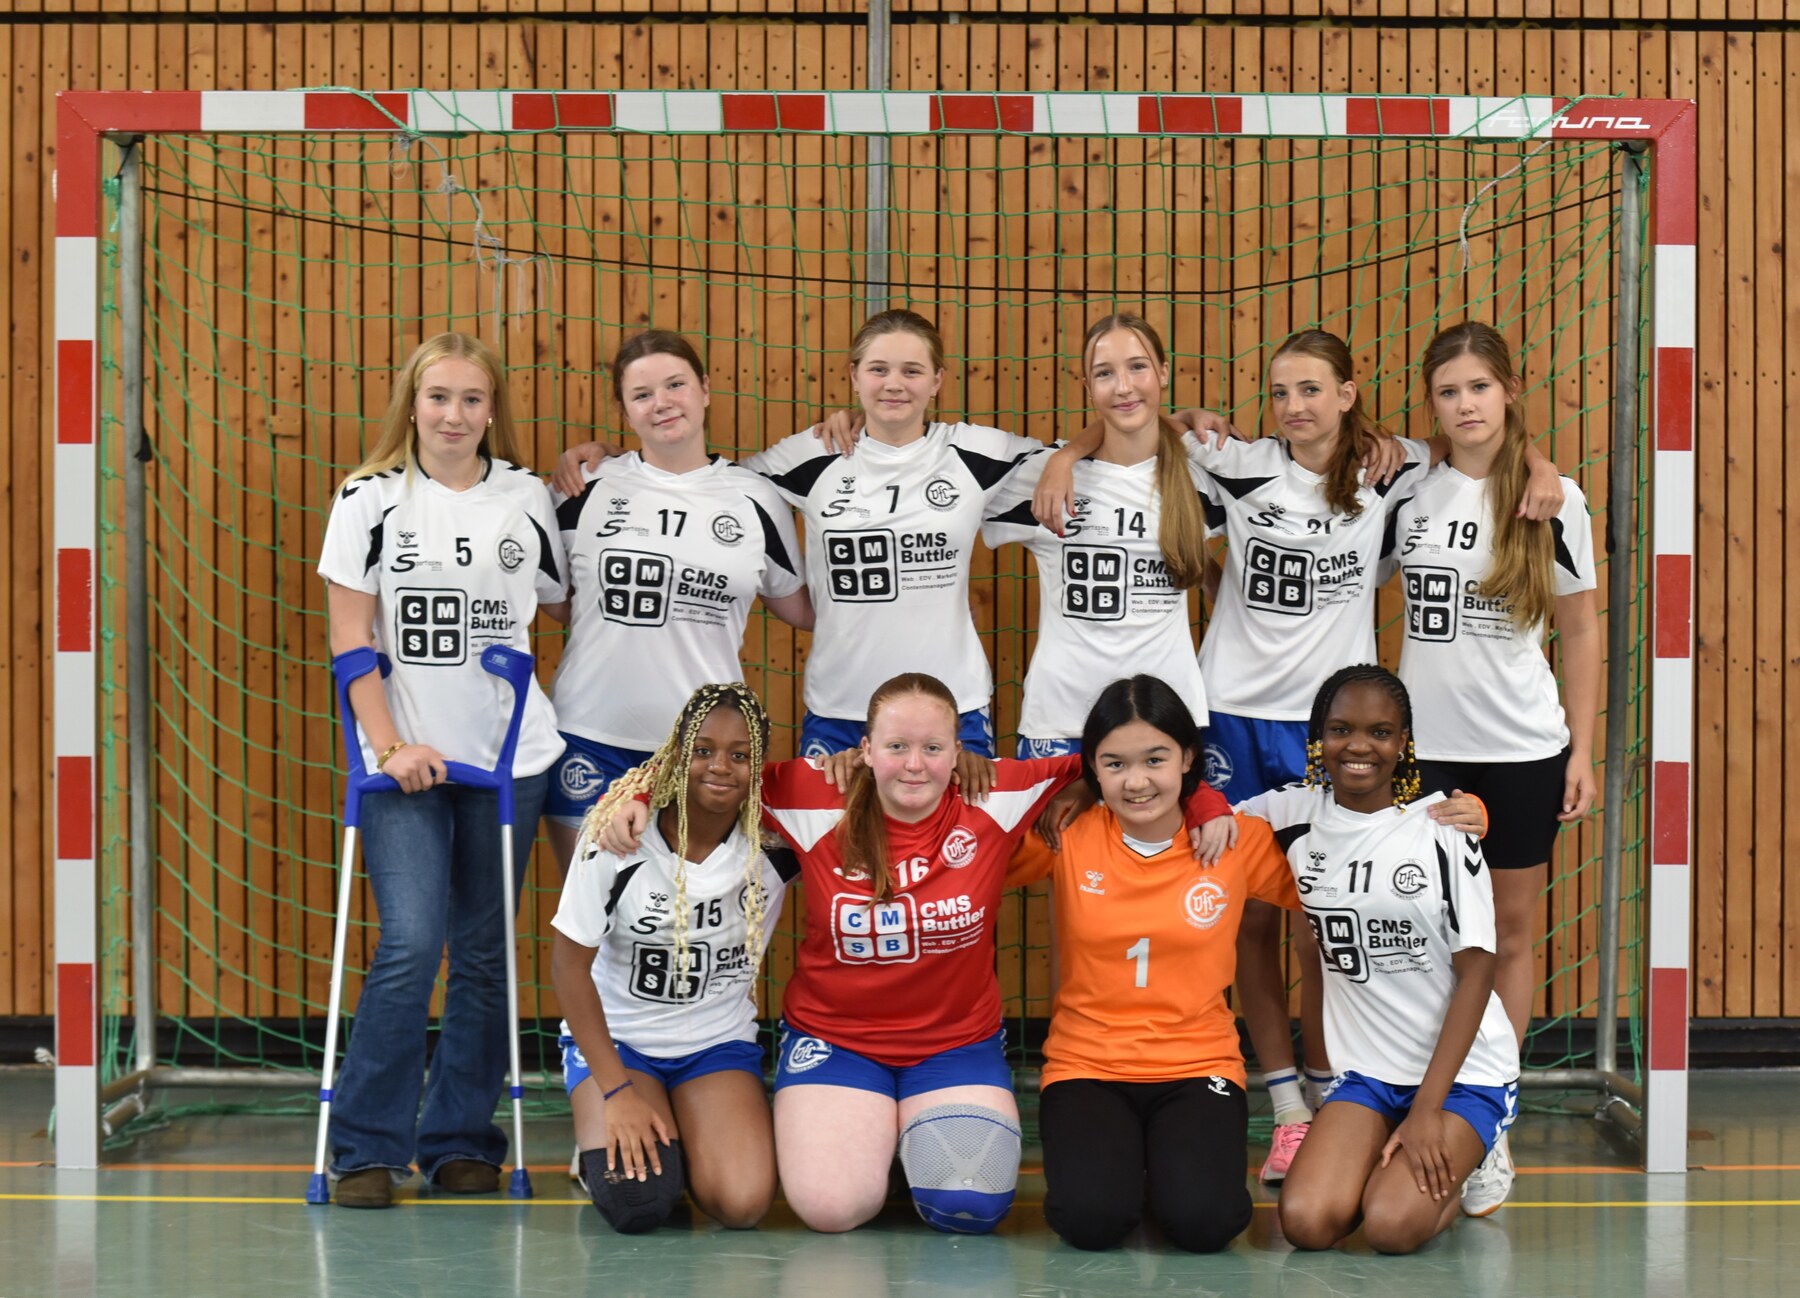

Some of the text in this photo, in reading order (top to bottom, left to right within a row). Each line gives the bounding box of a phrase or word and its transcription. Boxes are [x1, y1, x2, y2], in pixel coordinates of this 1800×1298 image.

[886, 485, 900, 513] 7
[657, 508, 688, 537] 17
[1114, 507, 1146, 538] 14
[900, 532, 947, 548] CMS
[1447, 520, 1478, 550] 19
[455, 537, 472, 567] 5
[901, 549, 959, 563] Buttler
[1316, 550, 1358, 573] CMS
[1134, 558, 1166, 574] CM
[1319, 566, 1364, 585] Buttle
[681, 568, 728, 589] CMS
[1134, 575, 1174, 587] Buttl
[677, 582, 738, 604] Buttler
[471, 599, 508, 615] CMS
[895, 857, 930, 888] 16
[1348, 860, 1373, 893] 11
[694, 898, 722, 929] 15
[920, 895, 972, 918] CMS
[921, 906, 986, 932] Buttler
[1366, 919, 1412, 935] CMS
[716, 944, 745, 962] CM
[1369, 935, 1428, 950] Buttler
[1126, 937, 1150, 988] 1
